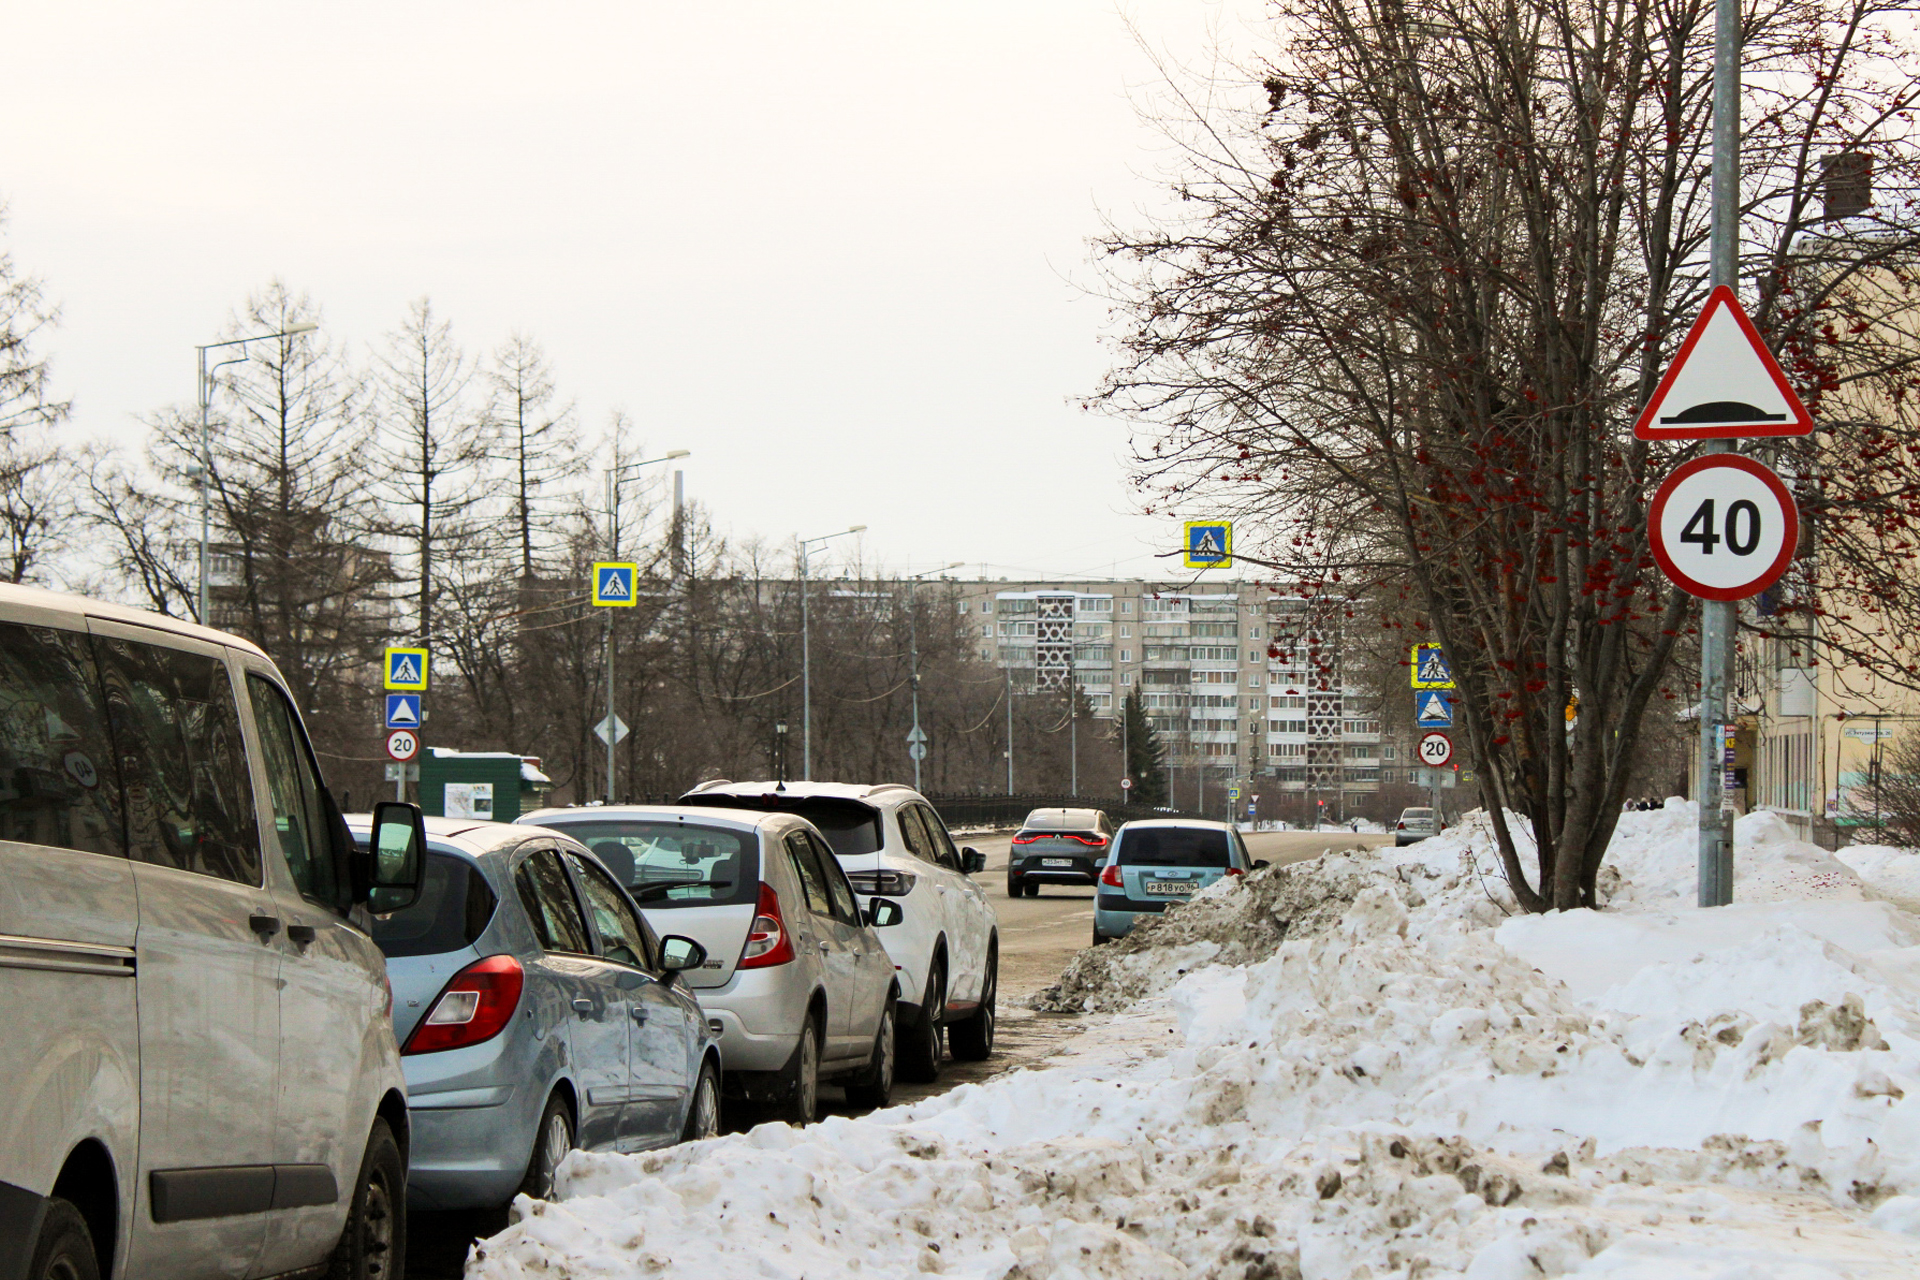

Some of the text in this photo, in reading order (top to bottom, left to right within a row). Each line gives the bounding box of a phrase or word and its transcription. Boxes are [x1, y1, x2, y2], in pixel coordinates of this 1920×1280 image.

[1680, 498, 1761, 557] 40
[394, 738, 412, 752] 20
[1425, 742, 1445, 756] 20
